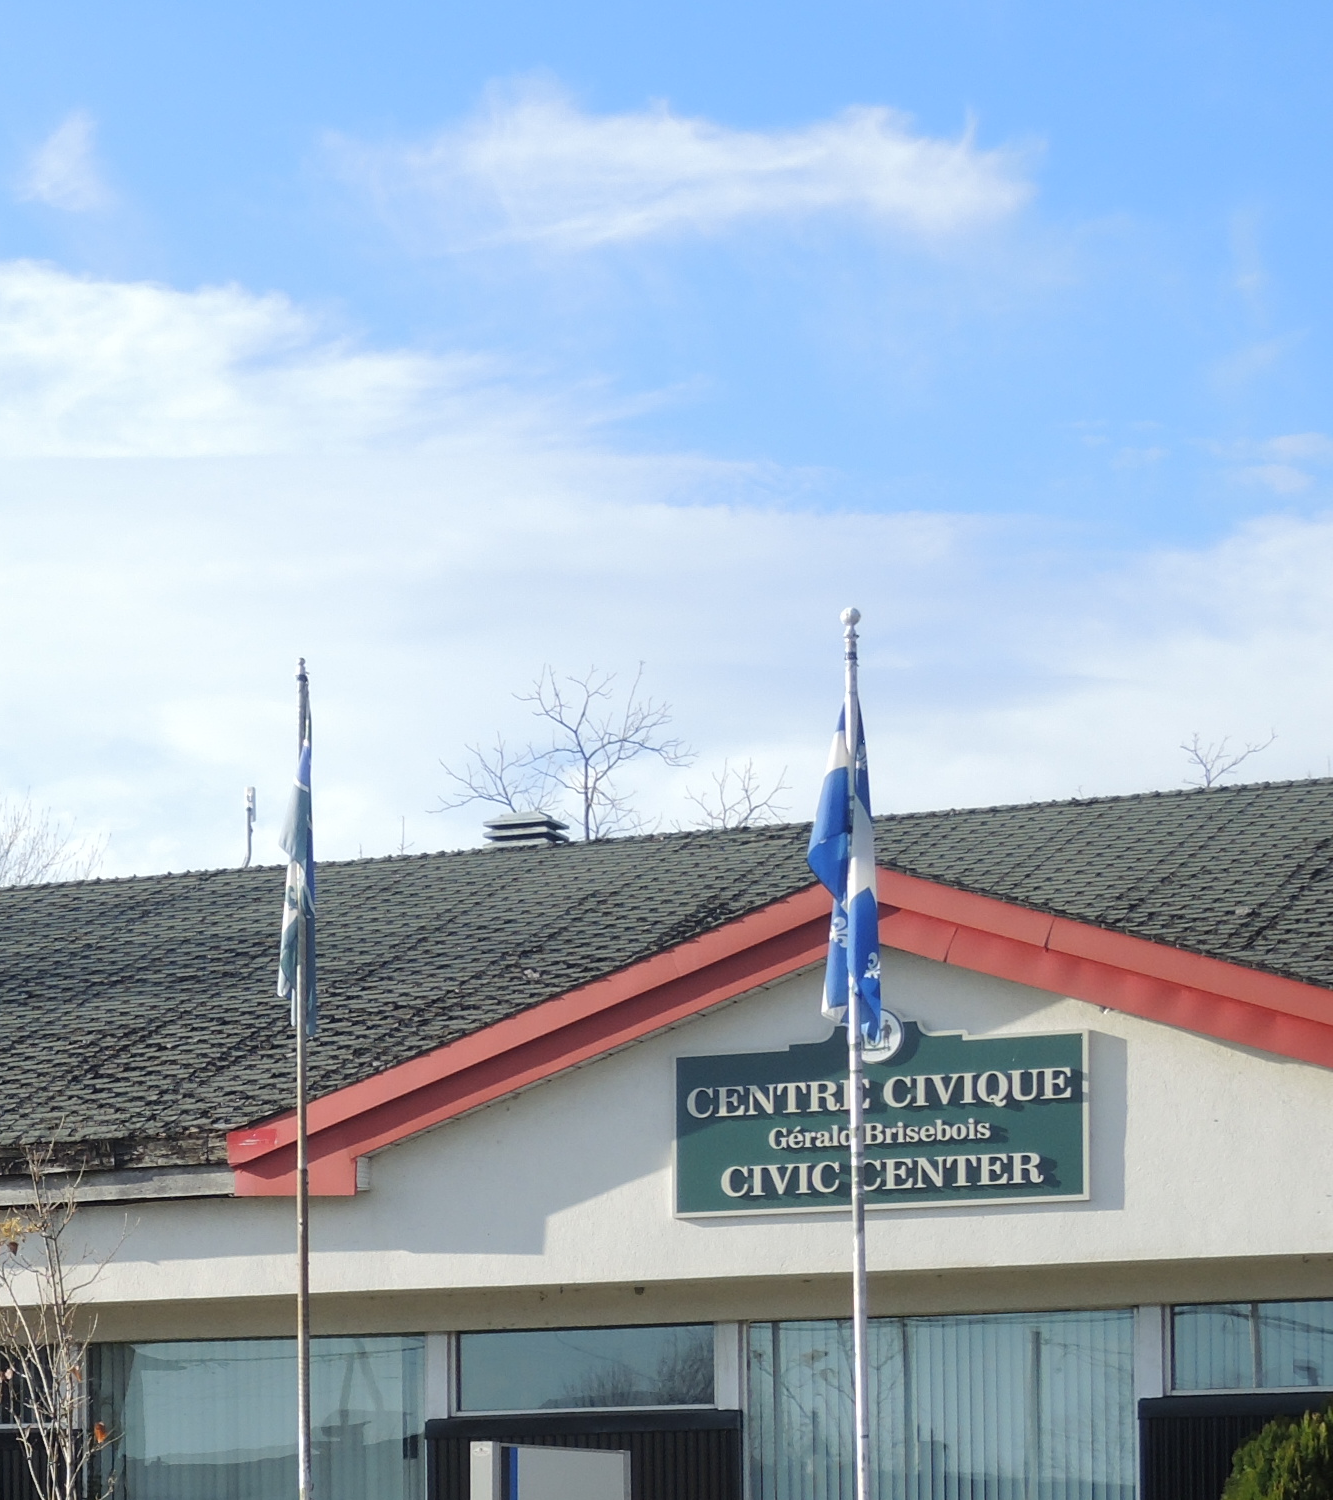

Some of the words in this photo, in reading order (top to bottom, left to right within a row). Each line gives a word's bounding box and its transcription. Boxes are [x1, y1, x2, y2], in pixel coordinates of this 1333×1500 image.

[686, 1080, 871, 1119] CENTRE
[882, 1066, 1073, 1109] CIVIQUE
[863, 1117, 992, 1145] Brisebois
[720, 1160, 841, 1198] CIVIC
[860, 1152, 1044, 1192] CENTER
